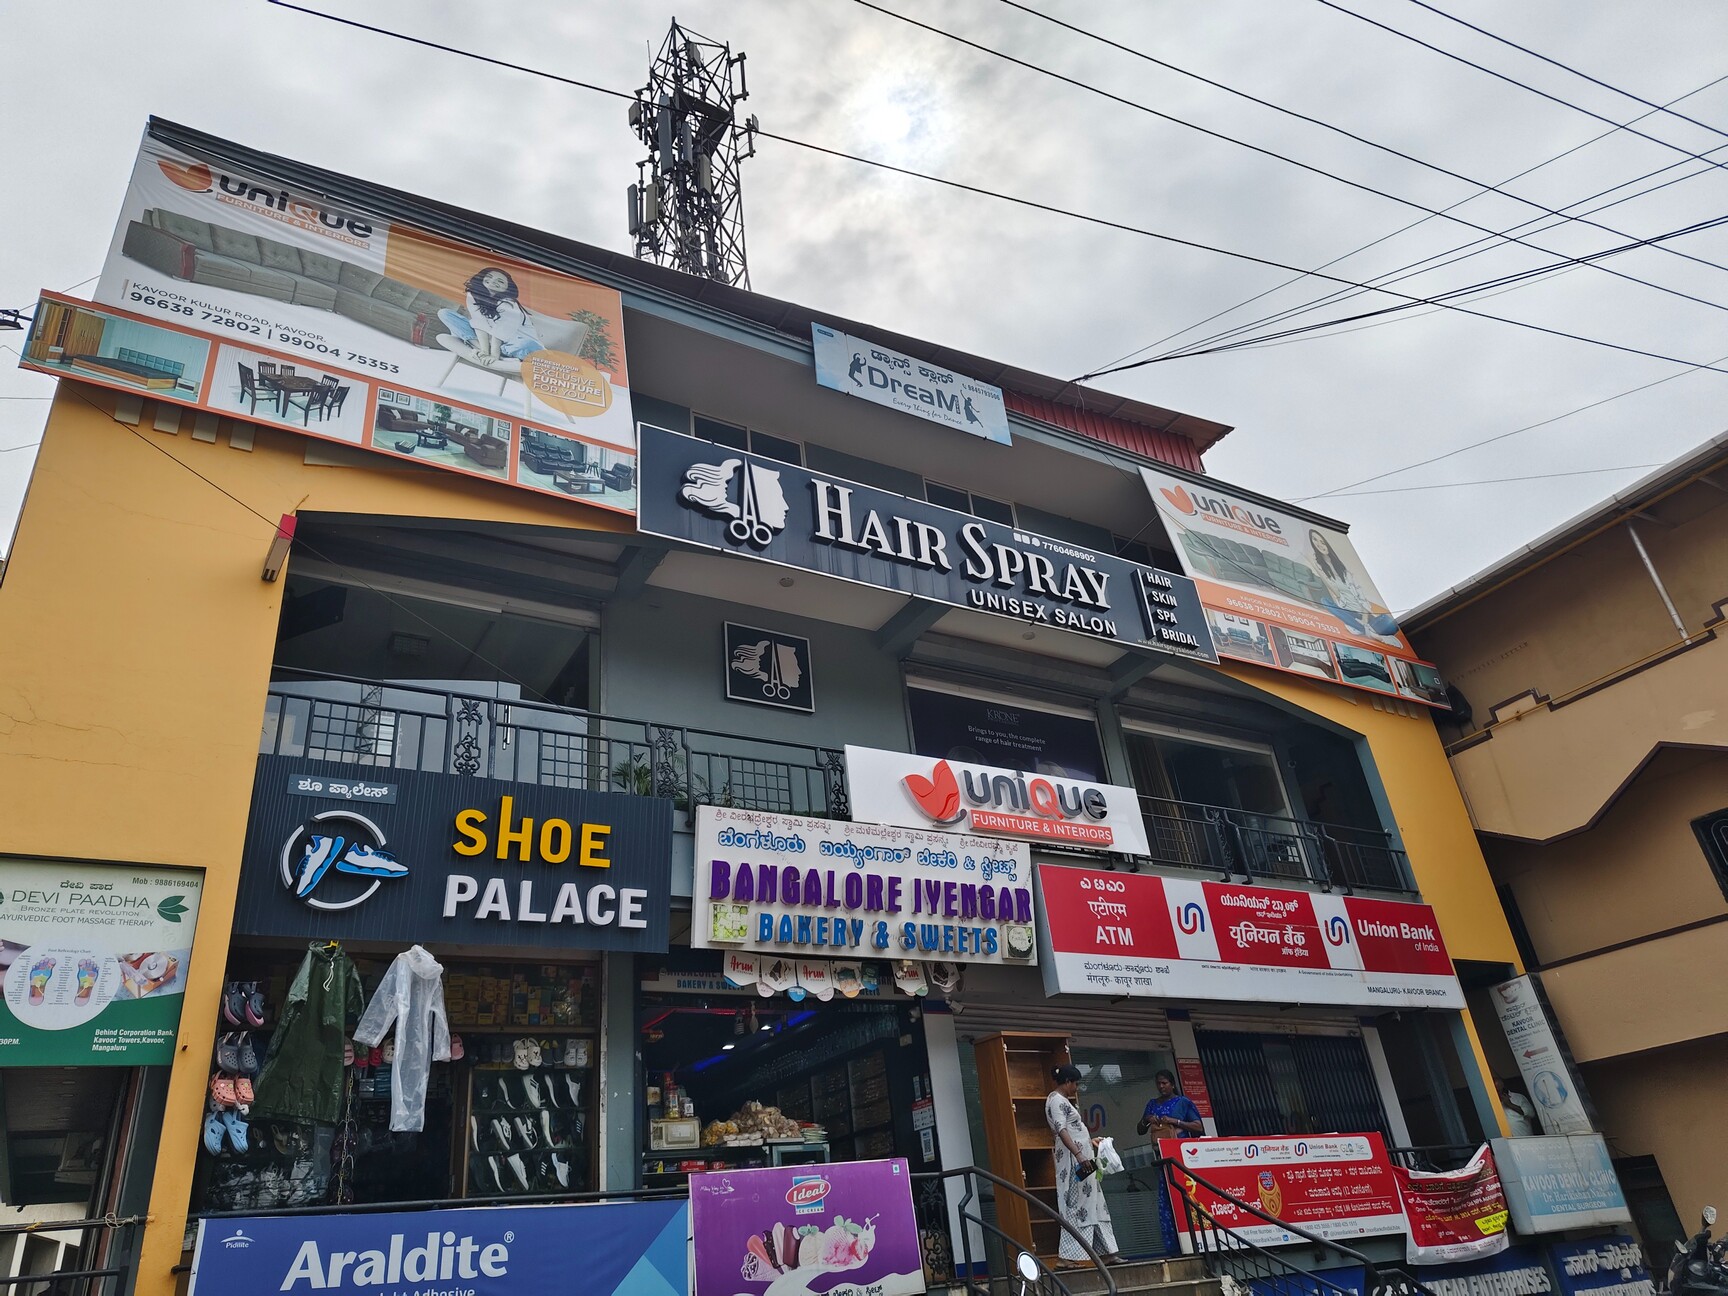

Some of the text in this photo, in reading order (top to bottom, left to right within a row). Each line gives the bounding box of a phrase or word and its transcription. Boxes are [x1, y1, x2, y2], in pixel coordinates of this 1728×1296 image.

[217, 194, 370, 249] FURNITURE & INTERIORS
[132, 282, 326, 343] KAVOOR KULUR ROAD, KAVOOR.
[130, 292, 400, 374] 96638 72802 99004 75353
[532, 356, 580, 372] REFRESH YOUR
[533, 366, 596, 387] EXCLUSIVE
[533, 373, 601, 396] FURNITURE
[533, 381, 586, 400] FOR YOU
[811, 478, 1111, 609] HAIR SPRAY
[1041, 541, 1096, 563] 7760468902
[1145, 572, 1173, 588] HAIR
[1151, 590, 1178, 607] SKIN
[971, 588, 1118, 636] UNISEX SALON
[1156, 609, 1178, 624] SPA
[1255, 605, 1282, 619] 72802
[1287, 614, 1315, 627] 99004
[1316, 621, 1341, 634] 75353
[1160, 627, 1201, 647] BRIDAL
[967, 724, 987, 735] Brings
[995, 730, 1008, 739] you,
[1019, 735, 1046, 744] complete
[975, 735, 993, 744] range
[999, 738, 1012, 747] hair
[1012, 741, 1042, 752] treatment
[297, 778, 388, 799] ಶೂ ಪ್ಯಾಲೇಸ್
[452, 795, 612, 869] SHOE
[715, 809, 727, 821] ಶ್ರೀ
[781, 817, 803, 830] ಸ್ವಾಮಿ
[844, 825, 855, 837] ಶ್ರೀ
[904, 832, 924, 844] ಸ್ವಾಮಿ
[959, 838, 969, 849] ಶ್ರೀ
[972, 812, 1112, 842] FURNITURE & INTERIORS
[718, 827, 1018, 882] ಬೆಂಗಳೂರು ಐಯ್ಯಂಗಾರ್ ಬೇಕರಿ & ಸ್ವೀಟ್ಸ್
[60, 880, 114, 891] ದೇವಿ ಪಾದ
[132, 877, 199, 888] Mob 9886169404
[710, 859, 1032, 923] BANGALORE IYENGAR
[11, 890, 150, 909] DEVI PAADHA
[442, 873, 648, 929] PALACE
[1086, 896, 1128, 921] एटीएम
[1220, 893, 1299, 918] ಯೂನಿಯನ್ ಬ್ಯಾಂಕ್
[0, 913, 155, 927] AYURVEDIC FOOT MASSAGE THERAPY
[20, 905, 57, 913] BRONZE
[89, 908, 140, 917] REVOLUTION
[757, 912, 999, 955] BAKERY & SWEETS
[1096, 925, 1134, 946] ATM
[1228, 920, 1306, 948] यूनियन बैंक
[1357, 919, 1435, 941] Union Bank
[1414, 943, 1439, 953] of India
[730, 955, 753, 972] Arun
[802, 965, 825, 979] Arun
[676, 979, 706, 990] BAKERY
[1133, 976, 1152, 986] शाखा
[1402, 987, 1424, 995] KAVOOR
[1425, 988, 1446, 996] BRANCH
[1506, 1020, 1546, 1036] DENTAL CLINIC
[1511, 1016, 1534, 1027] KAVOOR
[95, 1028, 174, 1037] Behind Corporation Bank,
[92, 1044, 127, 1052] Mangaluru
[1521, 1168, 1617, 1191] KAVOOR DENTAL CLINIC
[792, 1183, 826, 1202] Ideal
[1551, 1200, 1607, 1213] DENTAL SURGEON
[280, 1231, 509, 1291] Araldite
